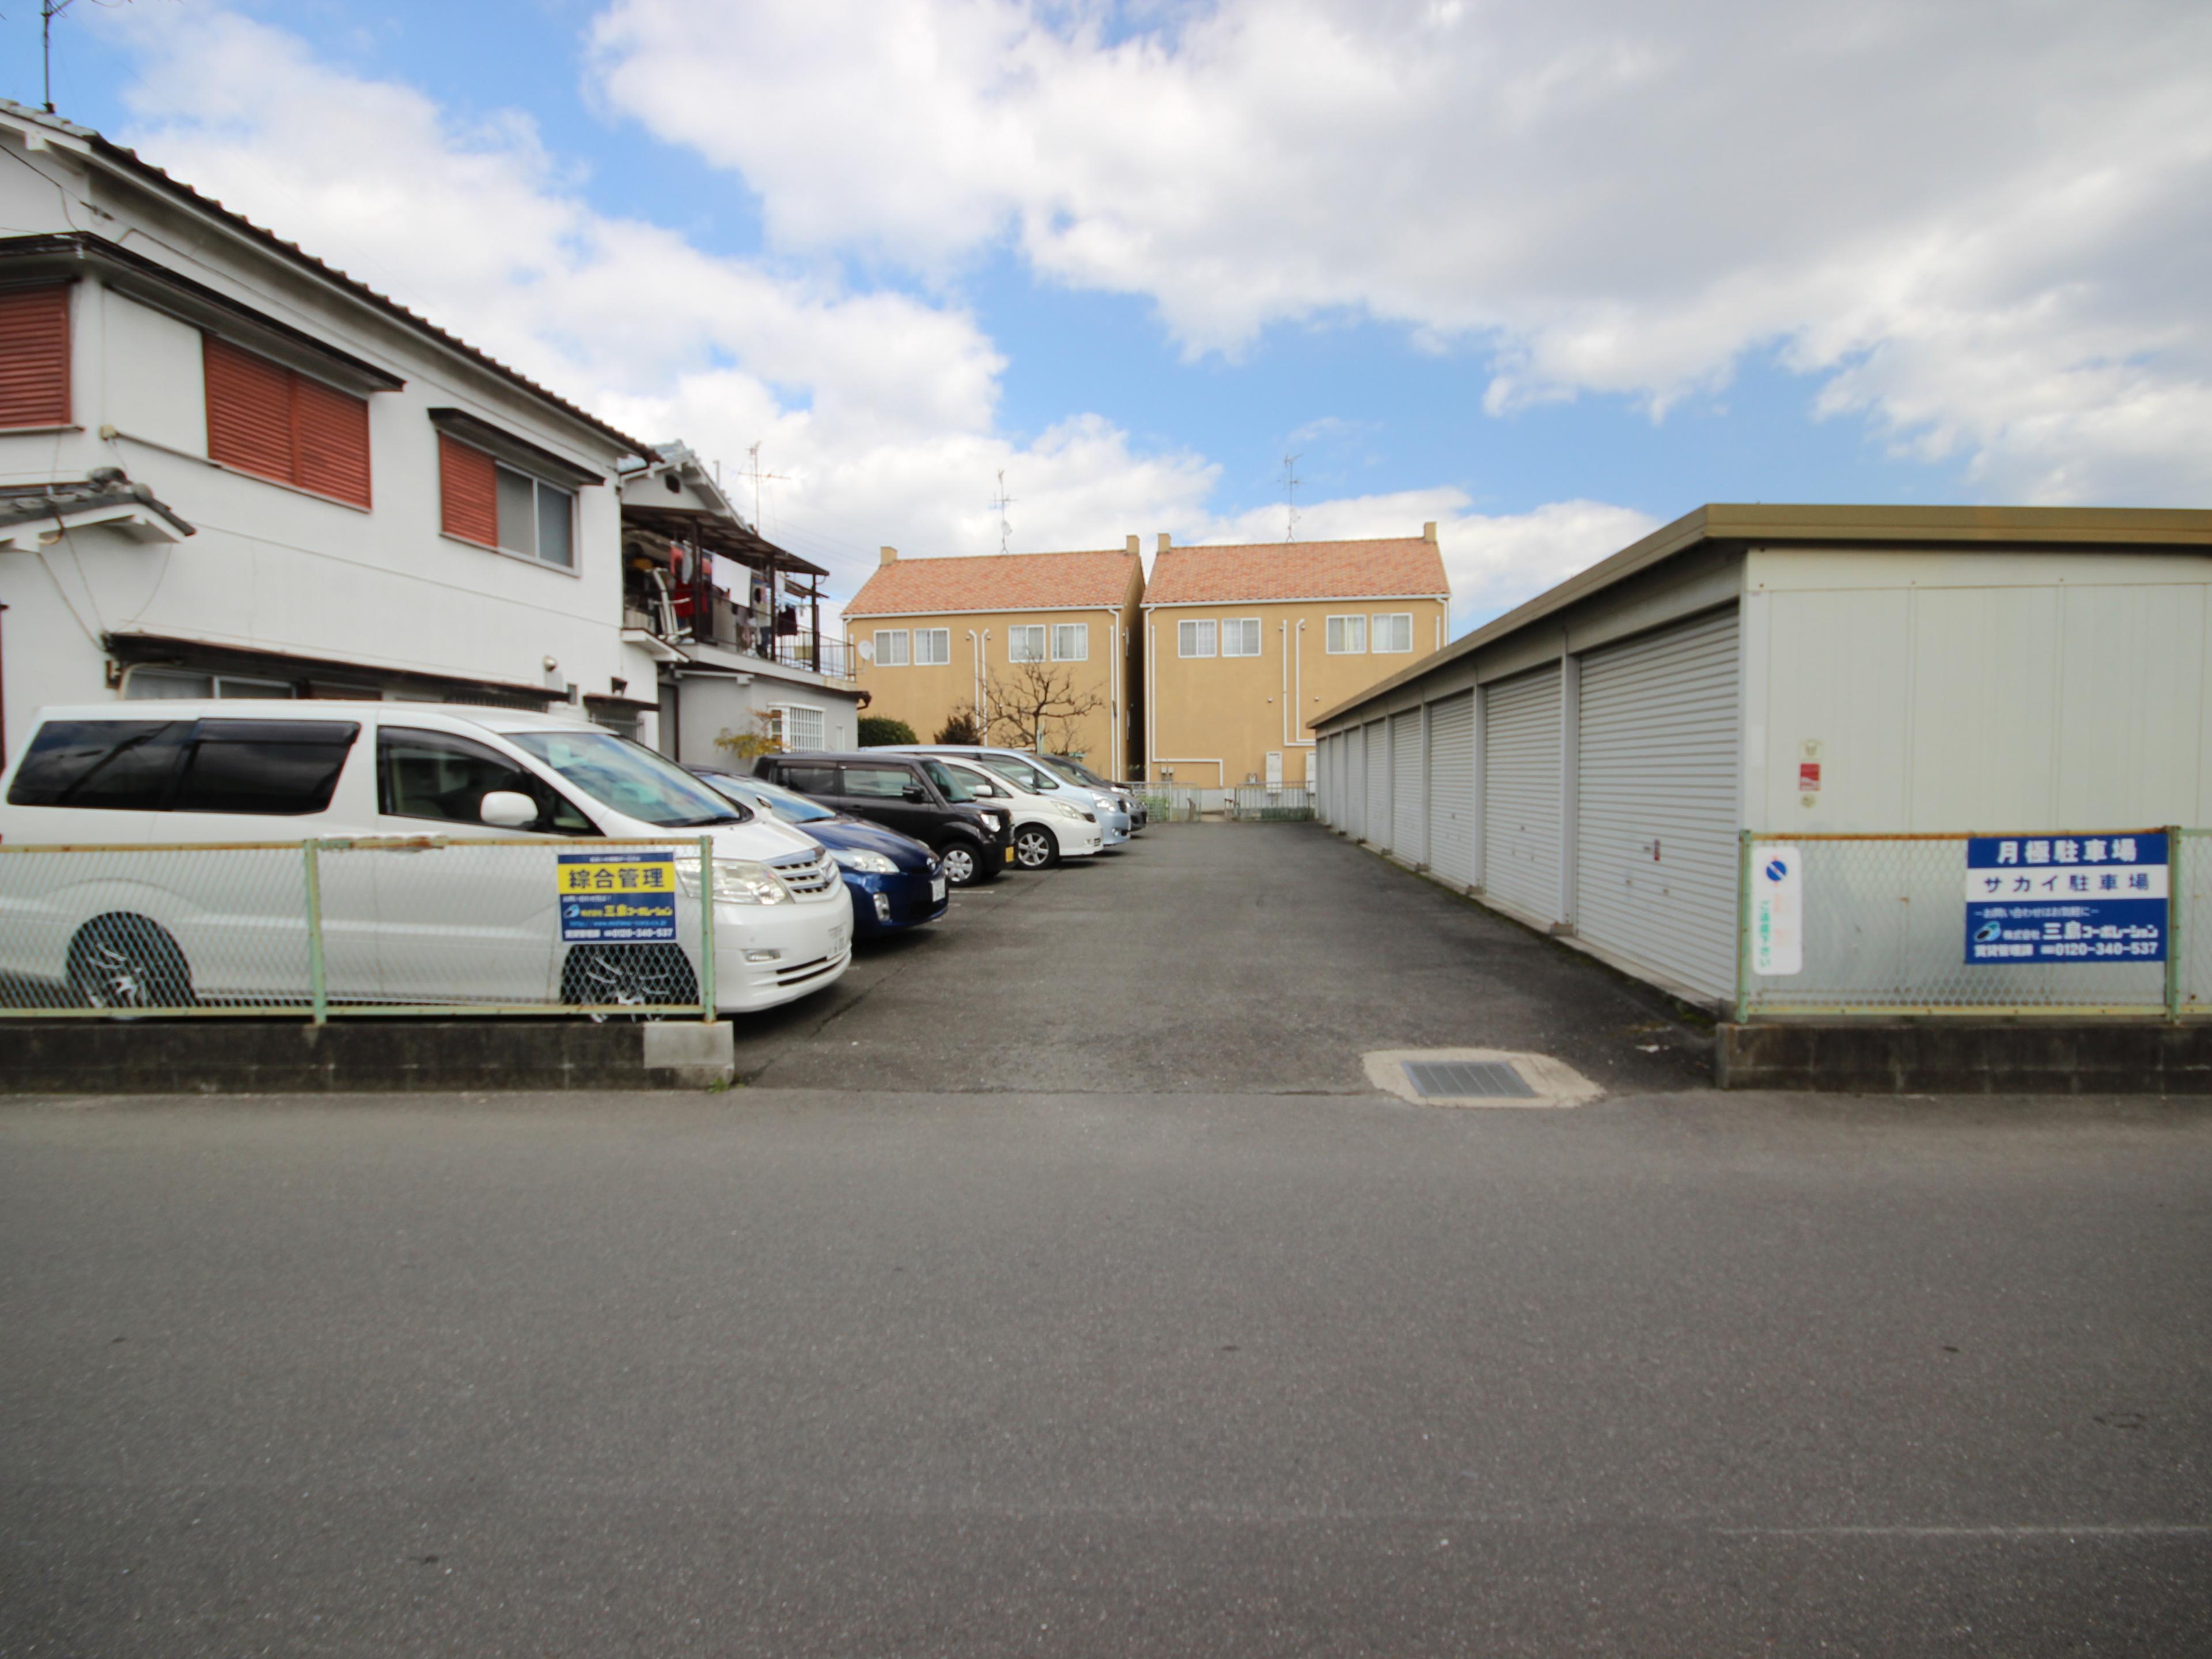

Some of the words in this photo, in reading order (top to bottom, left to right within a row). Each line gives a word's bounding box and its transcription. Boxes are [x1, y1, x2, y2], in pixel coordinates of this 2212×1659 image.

[1997, 838, 2137, 864] 月極駐車場
[1984, 873, 2149, 893] サカイ駐車場
